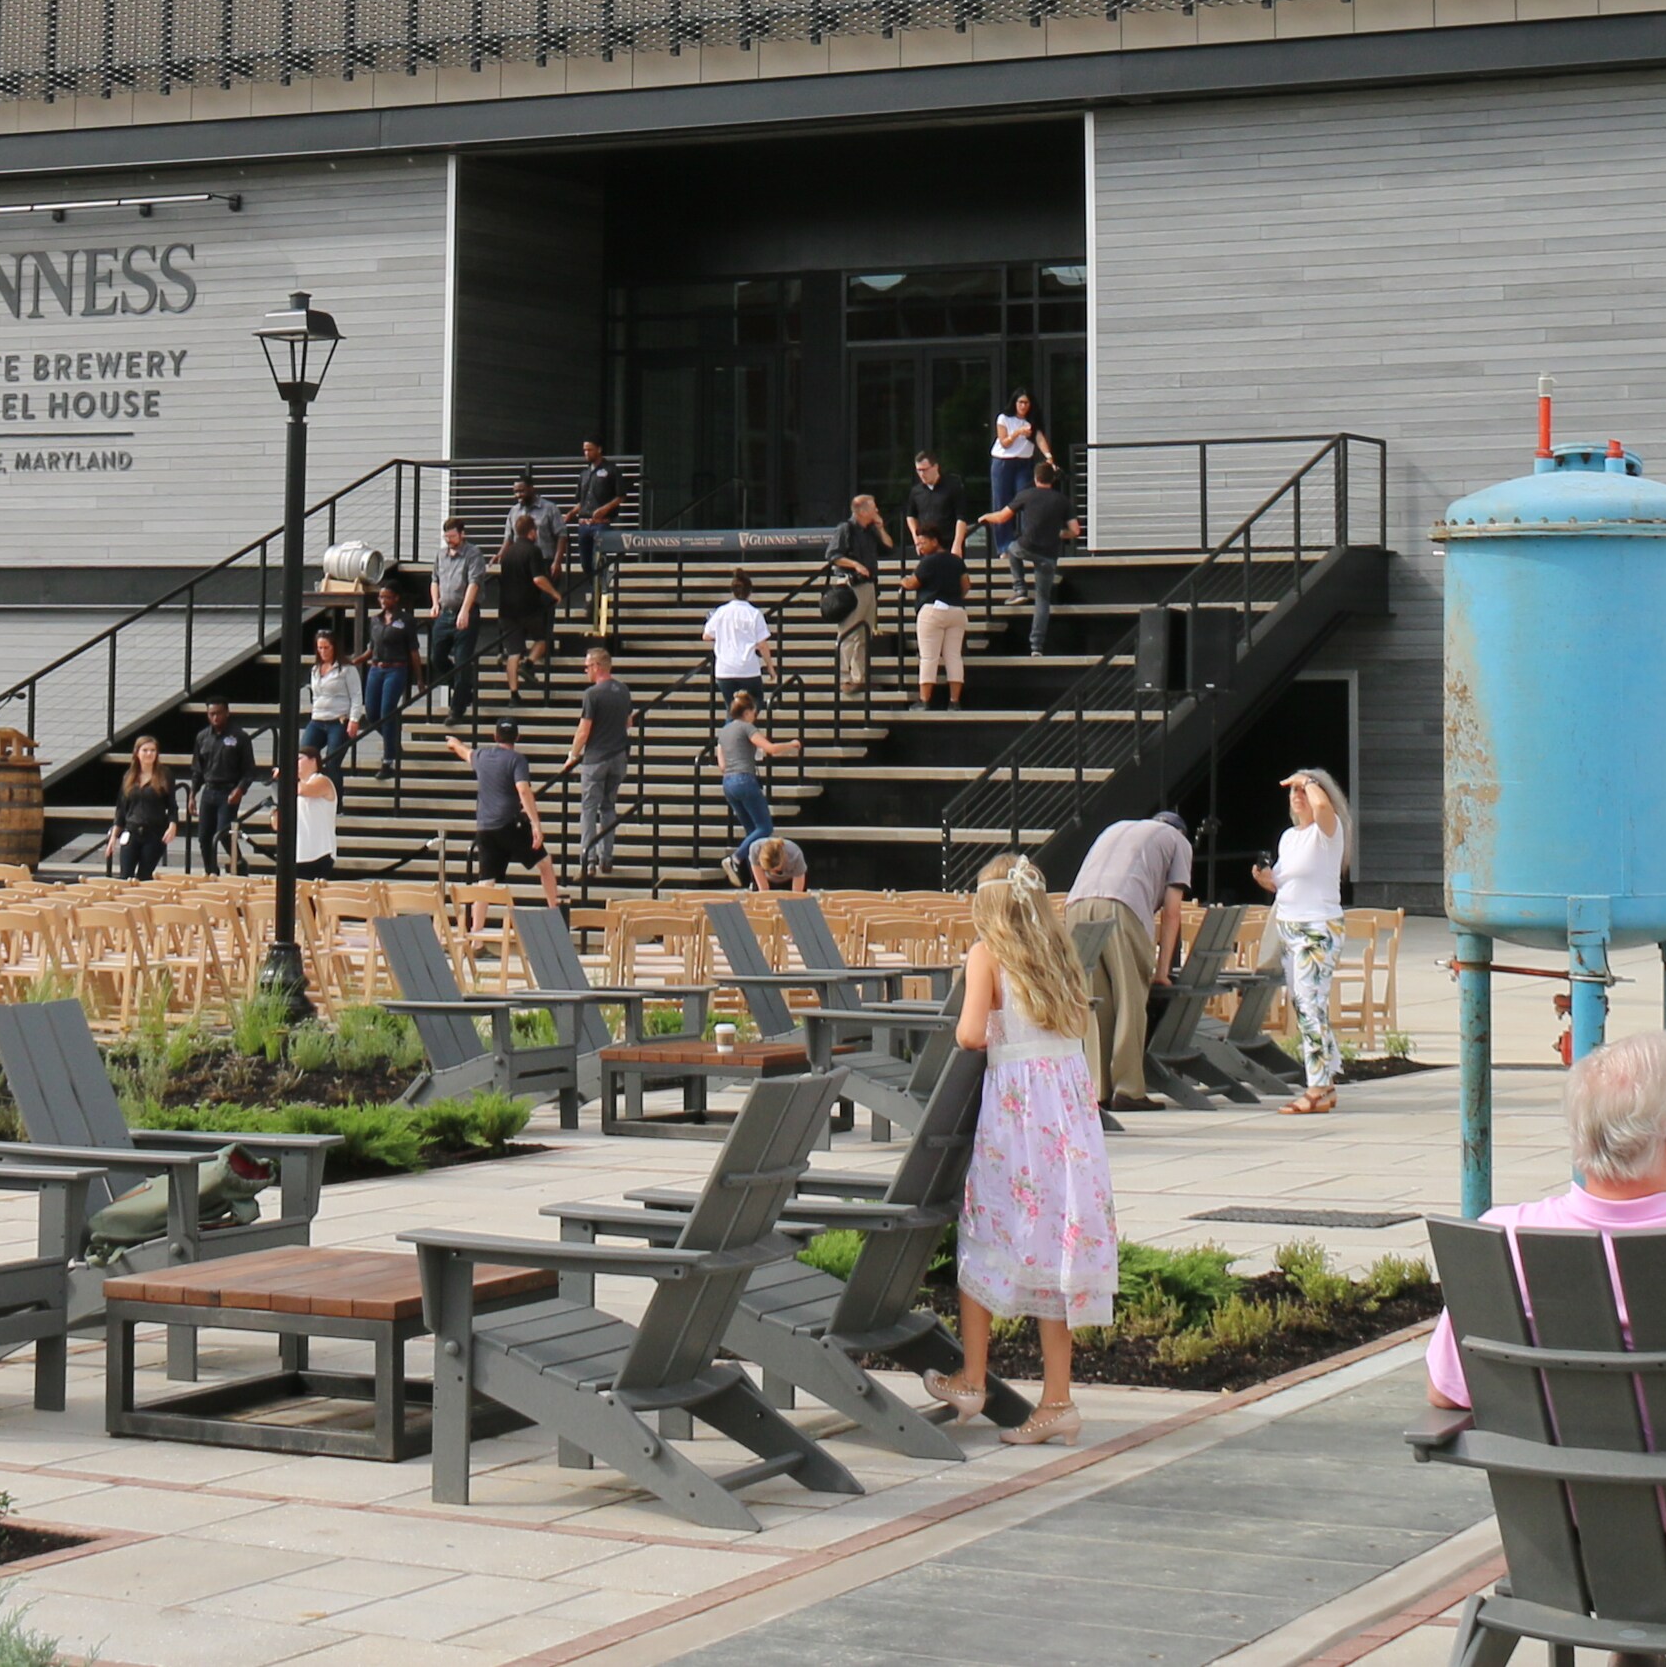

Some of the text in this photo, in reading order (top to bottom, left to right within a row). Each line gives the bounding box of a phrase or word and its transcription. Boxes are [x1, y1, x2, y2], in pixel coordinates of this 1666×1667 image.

[33, 349, 188, 381] BREWERY
[48, 390, 161, 419] HOUSE
[14, 450, 133, 472] MARYLAND
[633, 536, 681, 548] GUINNESS
[749, 534, 798, 546] GUINNESS
